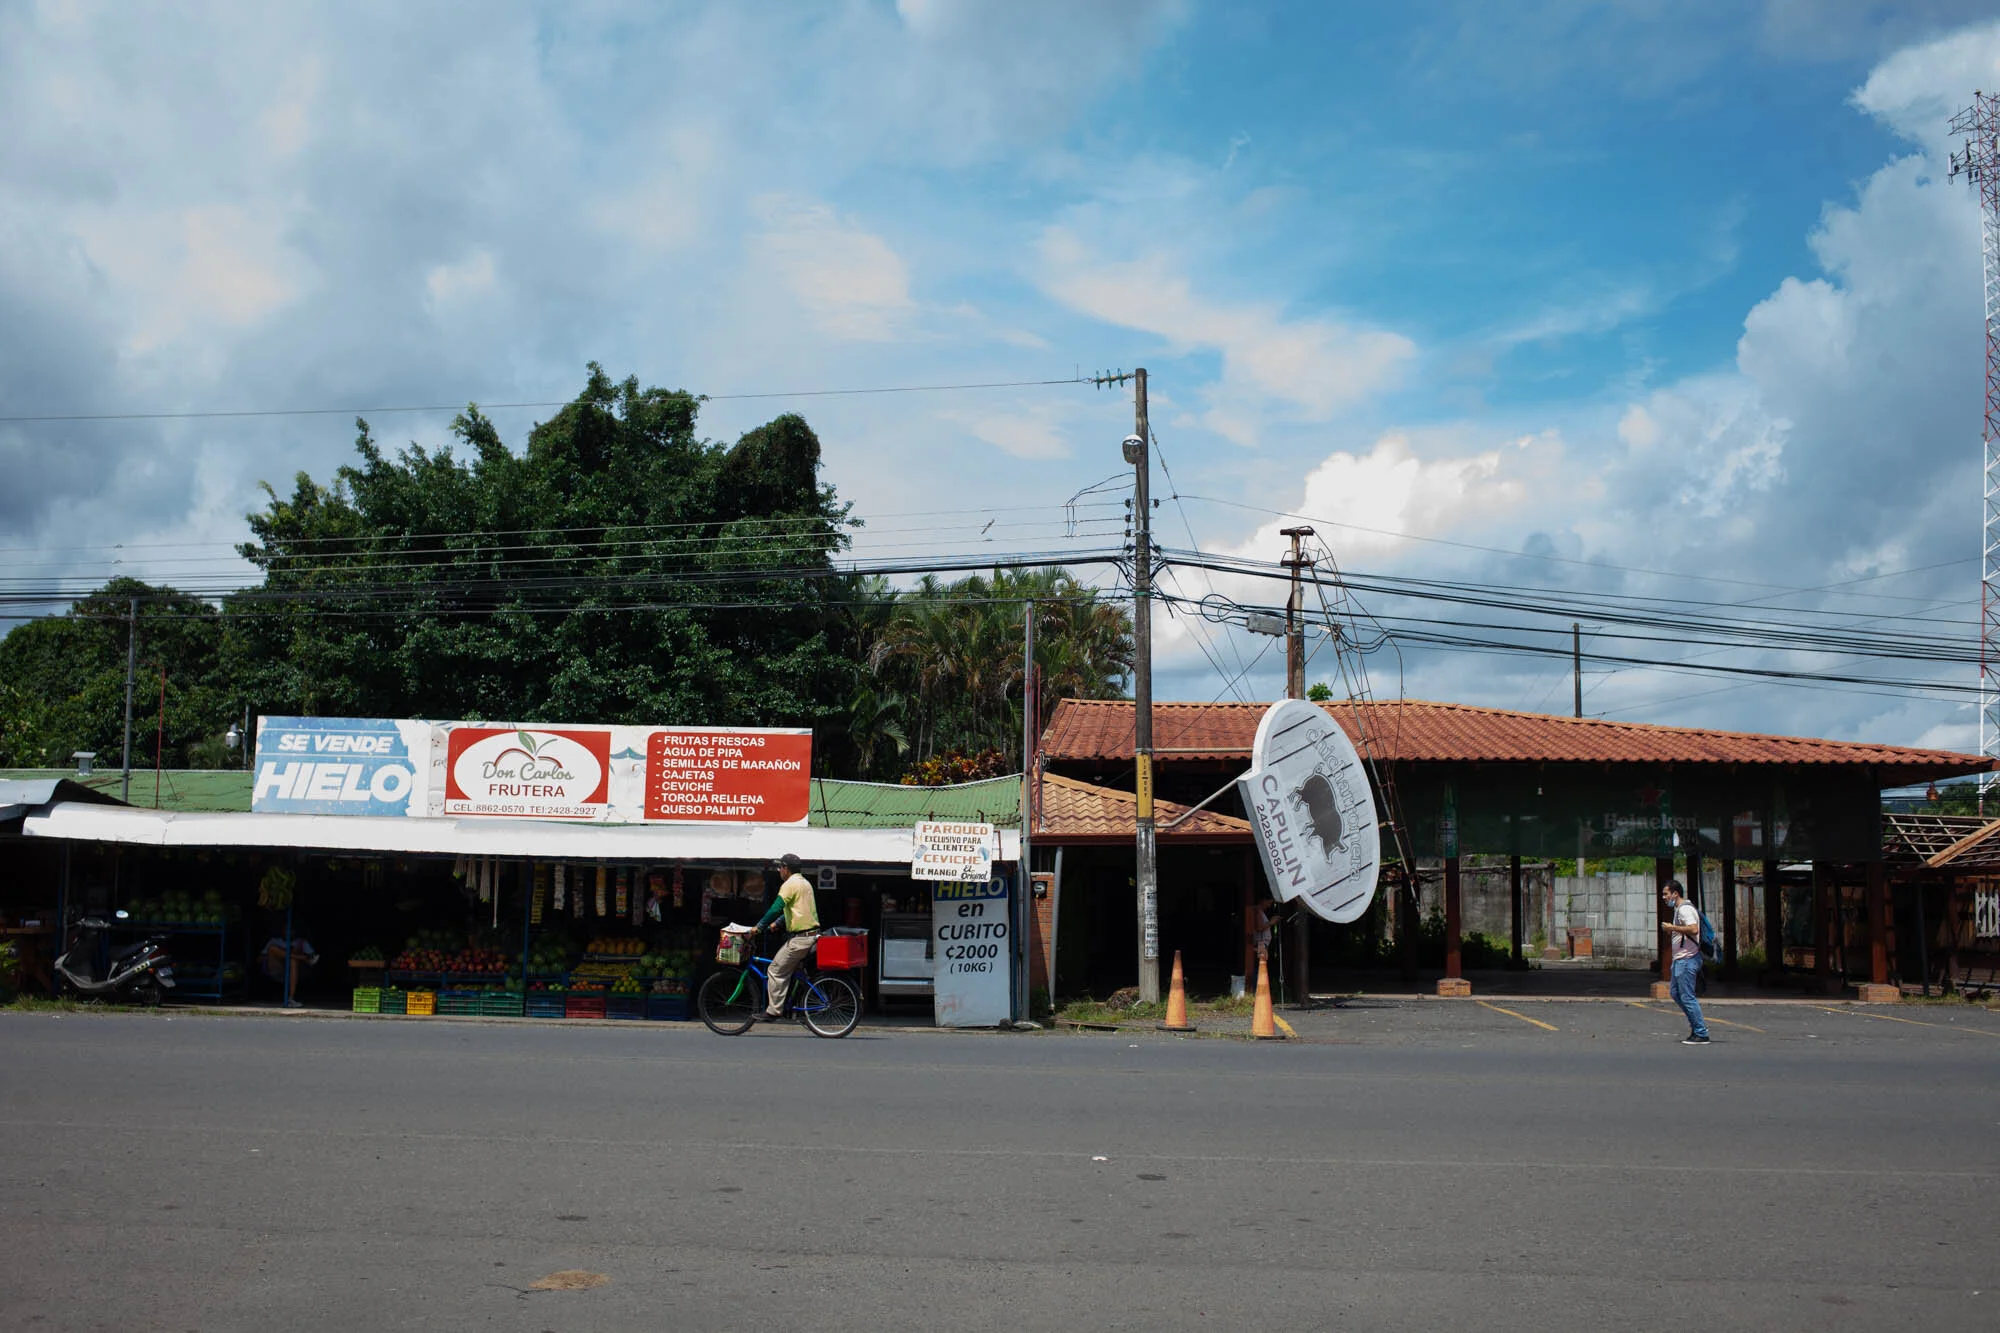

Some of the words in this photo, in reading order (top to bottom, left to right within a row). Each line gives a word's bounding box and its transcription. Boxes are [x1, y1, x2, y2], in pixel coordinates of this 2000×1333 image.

[278, 734, 309, 751] SE
[314, 734, 394, 753] VENDE
[664, 736, 709, 746] FRUTAS
[711, 737, 765, 747] FRESCAS
[663, 747, 696, 757] AGUA
[699, 748, 715, 757] DE
[717, 749, 743, 758] PIPA
[663, 759, 719, 769] SEMILLAS
[722, 760, 738, 769] DE
[740, 758, 801, 771] MARAÑÓN
[482, 761, 515, 780] Don
[520, 762, 574, 781] Carlos
[662, 770, 715, 780] CAJETAS
[253, 761, 413, 803] HIELO
[661, 781, 713, 792] CEVICHE
[488, 783, 565, 798] FRUTERA
[661, 792, 709, 804] TOROJA
[711, 794, 765, 804] RELLENA
[660, 804, 702, 815] QUESO
[704, 805, 756, 816] PALMITO
[1603, 813, 1697, 829] Heineken
[922, 824, 988, 836] PARQUEO
[1261, 774, 1306, 888] CAPULIN
[924, 835, 961, 844] EXCLUSIVO
[962, 837, 982, 845] PARA
[1255, 804, 1285, 876] 2428-8084
[931, 843, 976, 853] CLIENTES
[923, 854, 982, 865] CEVICHE
[915, 867, 925, 876] DE
[927, 868, 957, 877] MANGO
[960, 870, 988, 881] Original
[937, 877, 1004, 898] HIELO
[957, 902, 984, 918] en
[937, 923, 1007, 941] CUBITO
